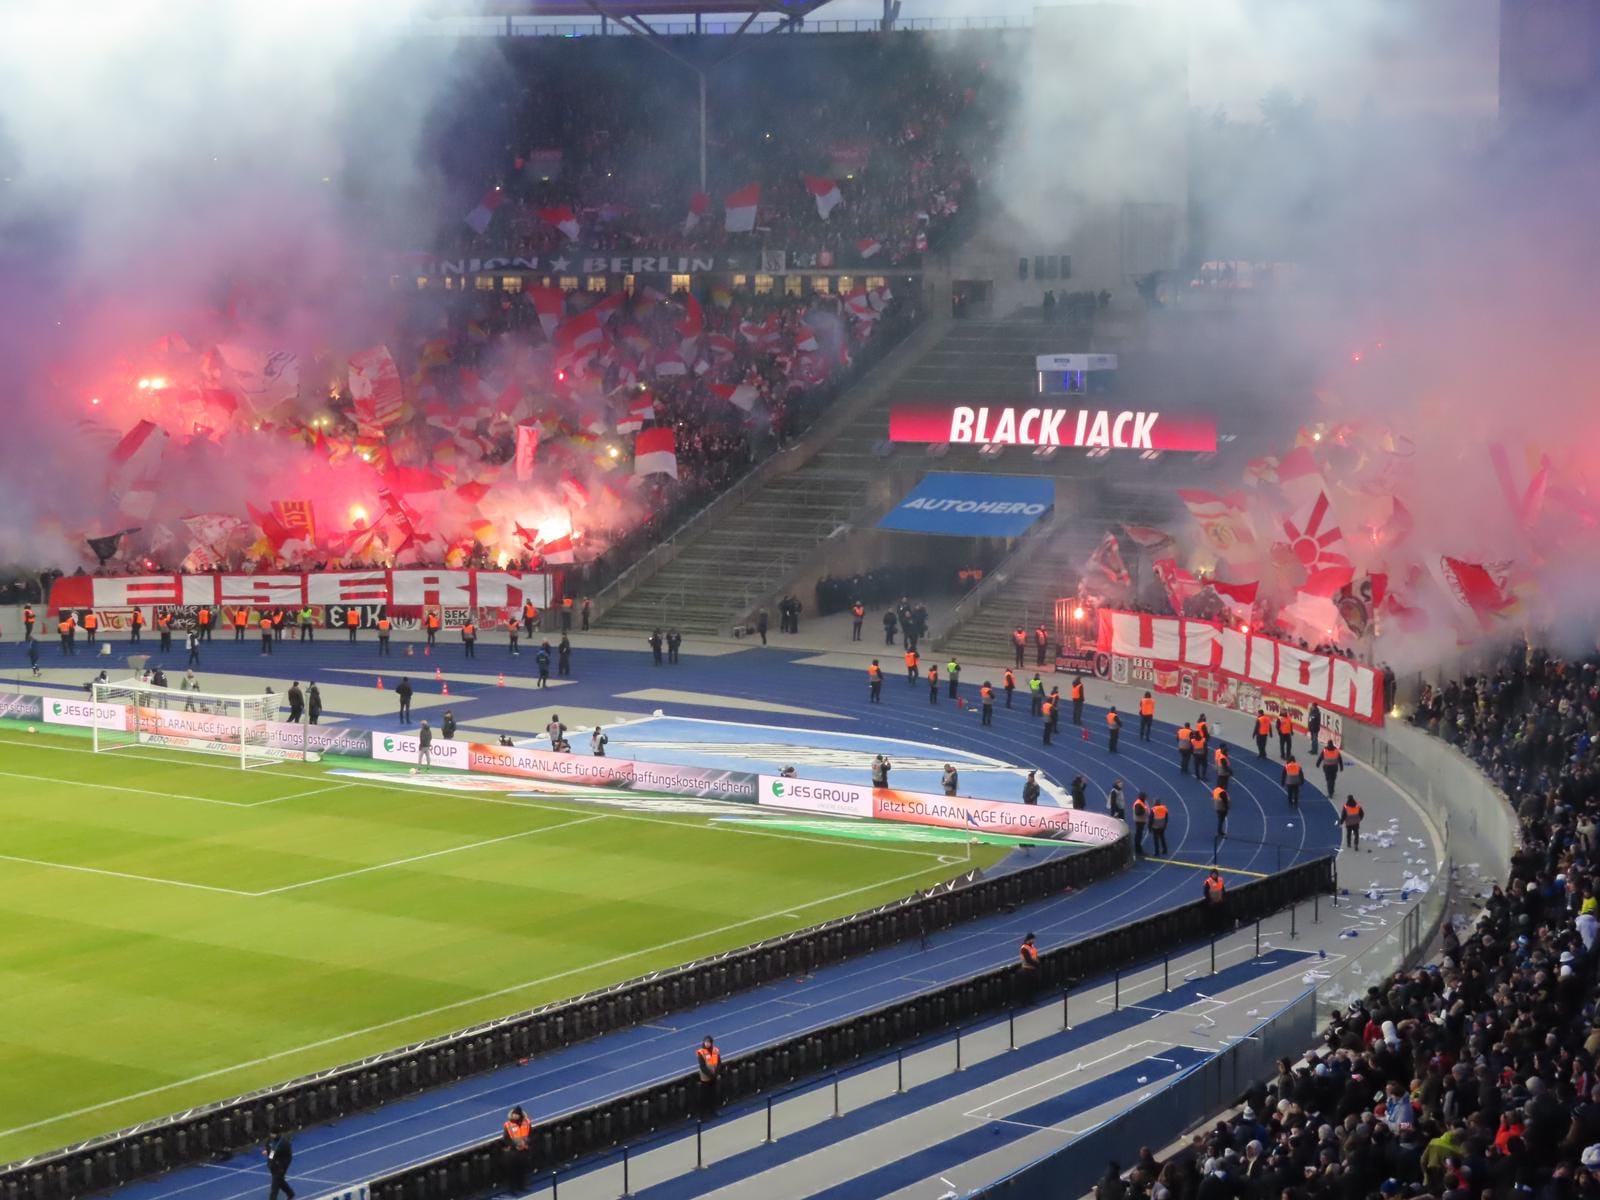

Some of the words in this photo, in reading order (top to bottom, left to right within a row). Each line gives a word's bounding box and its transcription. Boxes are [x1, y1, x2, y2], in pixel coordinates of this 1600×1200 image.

[583, 256, 714, 273] BERLIN
[949, 406, 1067, 445] BLACK
[902, 497, 1046, 515] AUTOHERO
[93, 570, 552, 608] EISERN
[445, 610, 467, 618] SEK
[1111, 612, 1374, 718] UNION
[64, 705, 81, 716] JES
[397, 740, 416, 753] JES
[474, 751, 497, 765] Jetzt
[499, 754, 573, 775] SOLARANLAGE
[575, 763, 589, 776] für
[607, 768, 711, 789] Anschaffungskosten
[713, 778, 755, 796] sichern!
[788, 785, 811, 798] JES
[813, 787, 860, 803] GROUP
[879, 799, 906, 812] Jetzt
[1000, 809, 1017, 825] für
[1020, 814, 1036, 828] 0€
